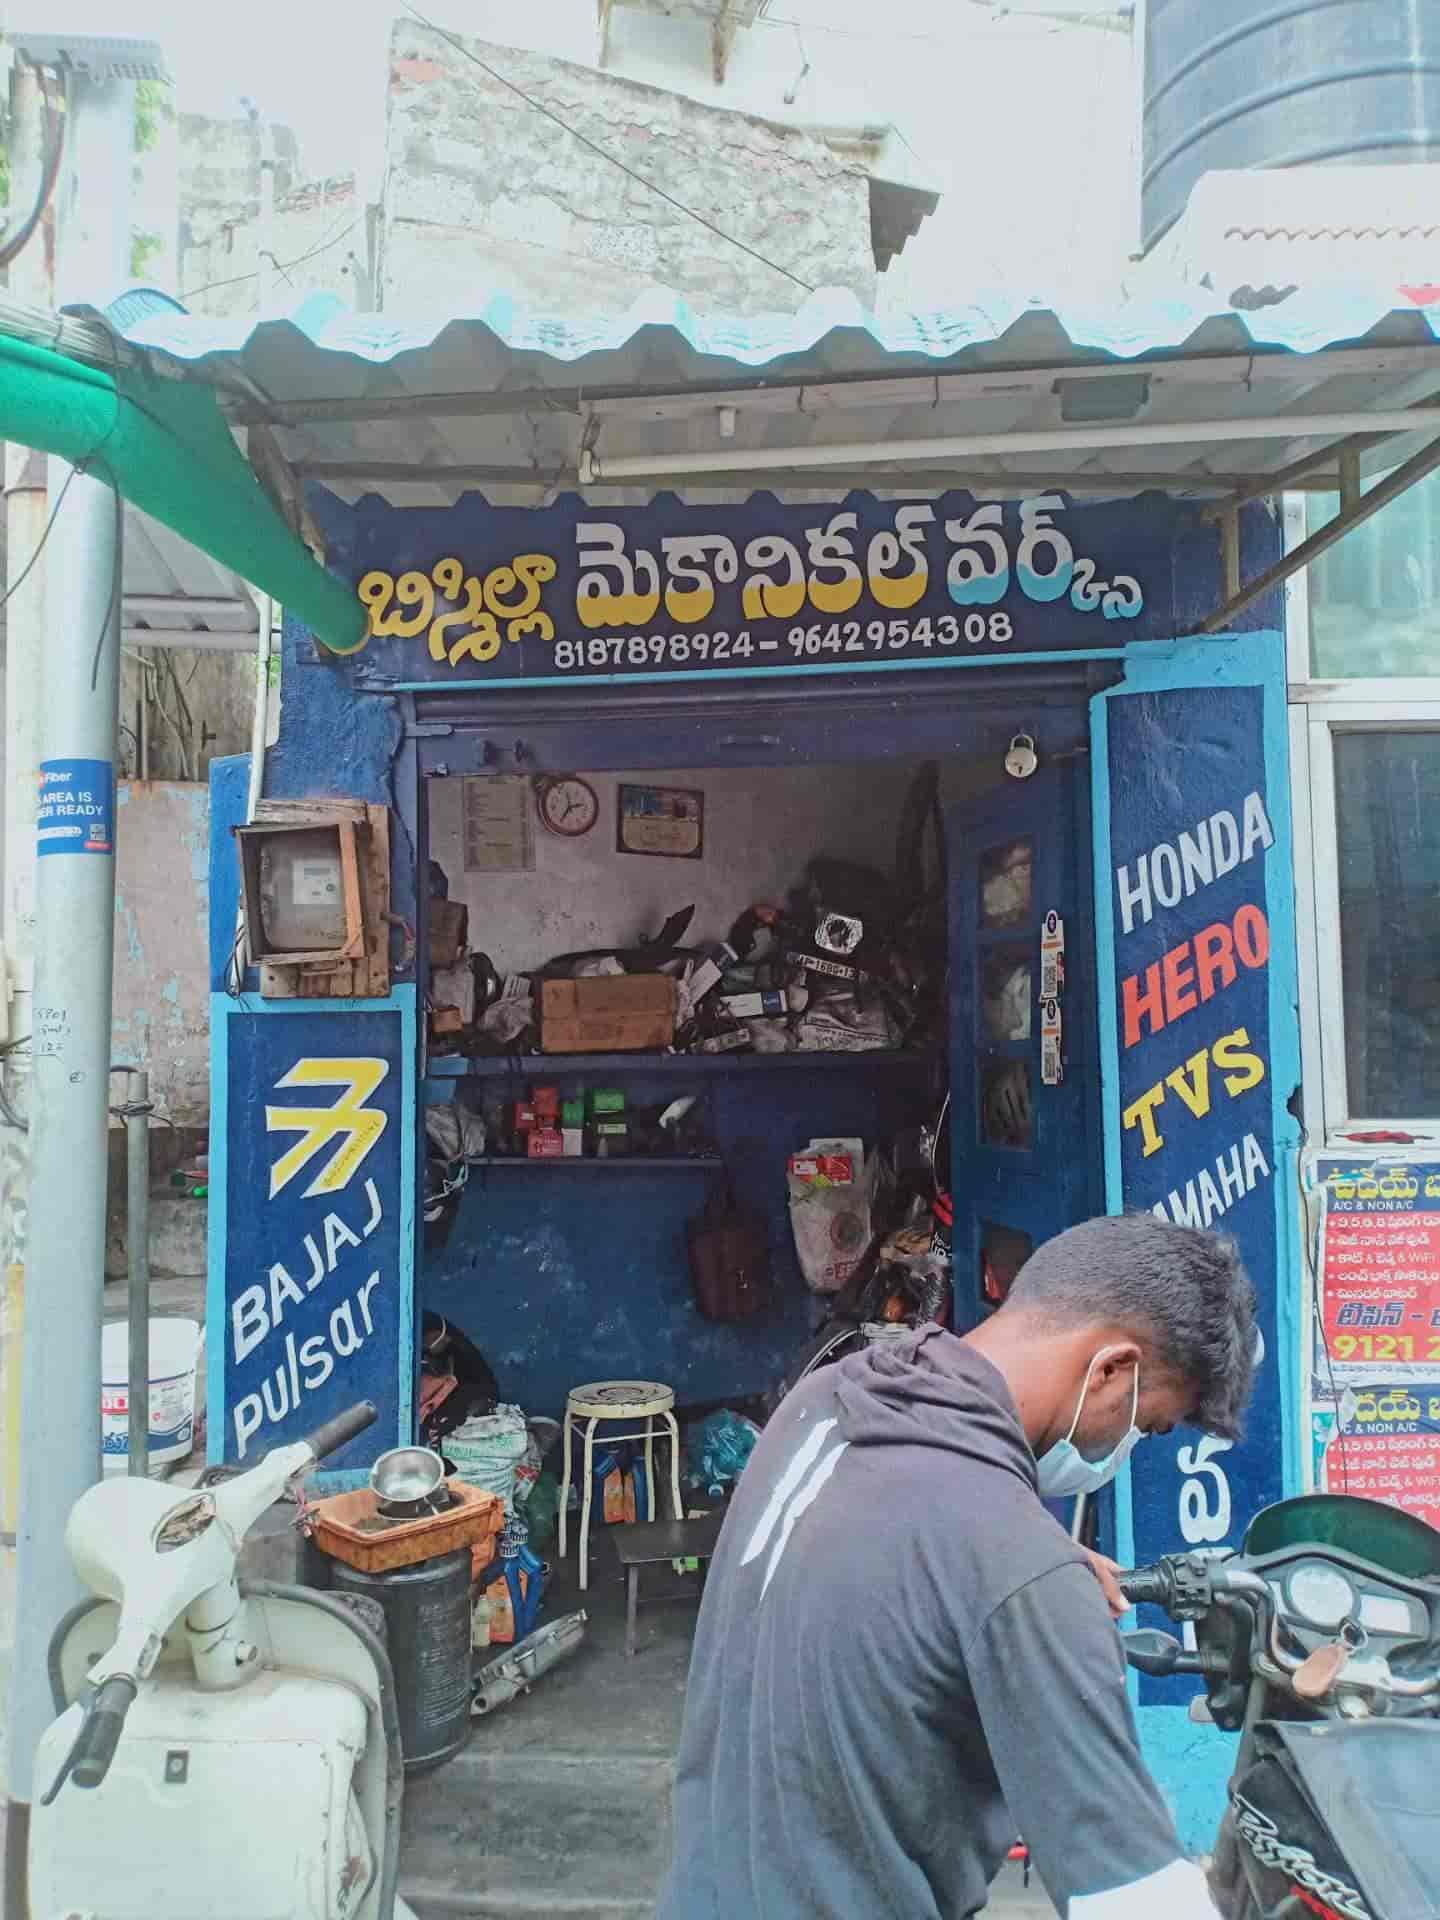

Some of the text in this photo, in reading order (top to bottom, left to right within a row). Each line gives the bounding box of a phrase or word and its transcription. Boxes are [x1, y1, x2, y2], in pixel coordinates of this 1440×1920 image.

[575, 505, 936, 628] మెకానికల్
[56, 804, 103, 817] READY
[1117, 791, 1275, 935] HONDA
[1121, 904, 1270, 1048] HERO
[1122, 1027, 1265, 1158] TVS
[233, 1178, 383, 1366] BAJAJ
[1333, 1335, 1414, 1361] 9121
[1367, 1423, 1394, 1434] NON
